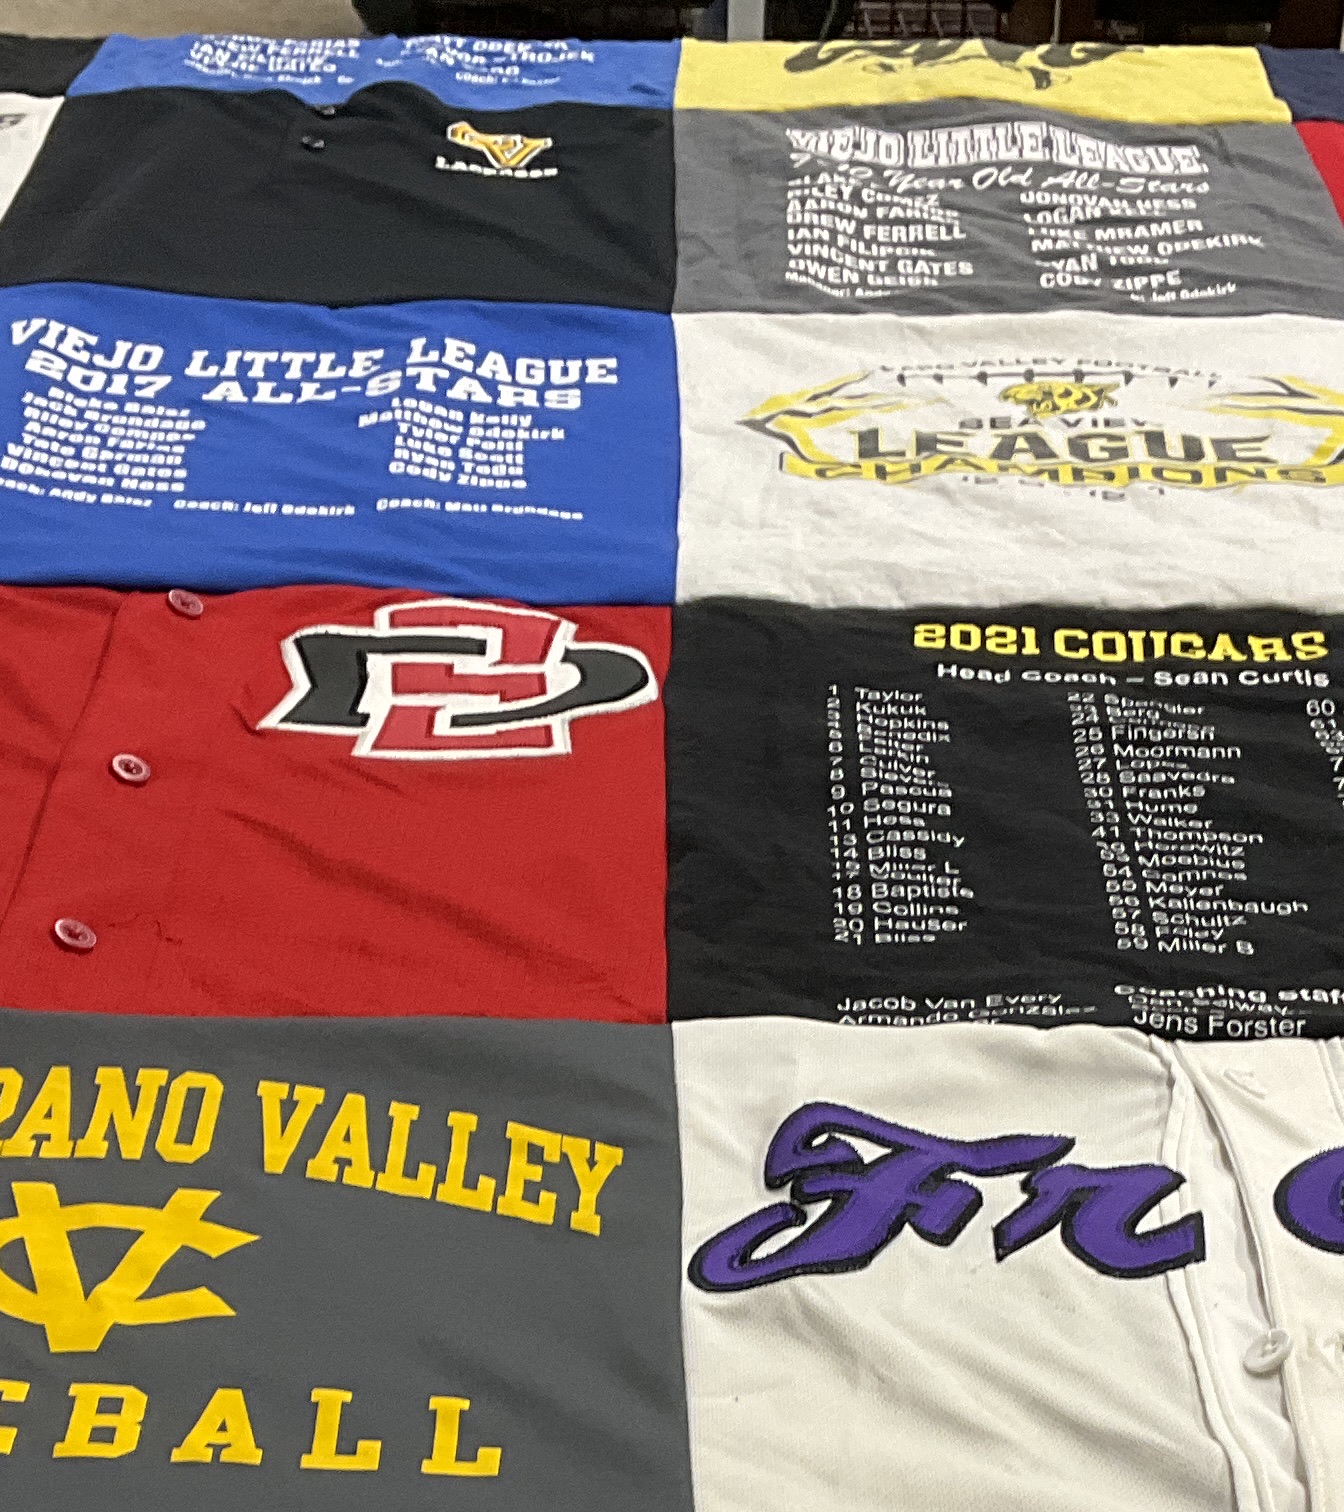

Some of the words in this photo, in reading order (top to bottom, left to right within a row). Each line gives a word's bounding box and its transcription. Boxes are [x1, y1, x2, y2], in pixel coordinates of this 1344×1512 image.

[785, 125, 904, 168] VIEJO
[907, 121, 1049, 168] LITTLE
[883, 169, 965, 193] Year
[972, 166, 1033, 190] Old
[1042, 168, 1209, 194] All-Stars
[787, 212, 856, 234] DREW
[863, 224, 966, 243] FERRELL
[788, 228, 829, 240] IAN
[788, 244, 889, 272] VINCENT
[898, 260, 973, 276] GATES
[789, 259, 859, 283] OWEN
[11, 318, 164, 371] VIEJO
[185, 349, 385, 379] LITTLE
[407, 337, 619, 386] LEAGUE
[25, 349, 172, 398] 2017
[202, 366, 582, 410] ALL-STARS
[854, 427, 1275, 464] LEAGUE
[913, 623, 1040, 656] 2021
[1053, 628, 1329, 663] COUGARS
[937, 663, 1011, 685] Head
[1021, 666, 1117, 686] Coach
[1154, 669, 1229, 687] Sean
[1238, 669, 1330, 688] Curtis
[854, 686, 924, 702] Taylor
[1306, 698, 1336, 717] 60
[1113, 743, 1241, 759] Moormann
[1078, 757, 1106, 771] 27
[1122, 784, 1206, 799] Franks
[827, 801, 854, 818] 10
[828, 818, 851, 833] 11
[1127, 812, 1214, 829] Walker
[866, 829, 965, 848] Cassidy
[1091, 825, 1120, 838] 41
[1129, 826, 1263, 844] Thompson
[830, 847, 858, 859] 14
[832, 884, 862, 900] 18
[1145, 880, 1224, 897] Meyer
[872, 901, 959, 916] Collins
[1152, 909, 1247, 927] Schultz
[875, 916, 968, 931] Hauser
[1157, 937, 1227, 954] Miller
[837, 995, 917, 1012] Jacob
[925, 996, 976, 1010] Van
[986, 993, 1062, 1008] Every
[1133, 1009, 1198, 1036] Jens
[1208, 1010, 1307, 1037] Forster
[256, 1079, 624, 1236] VALLEY
